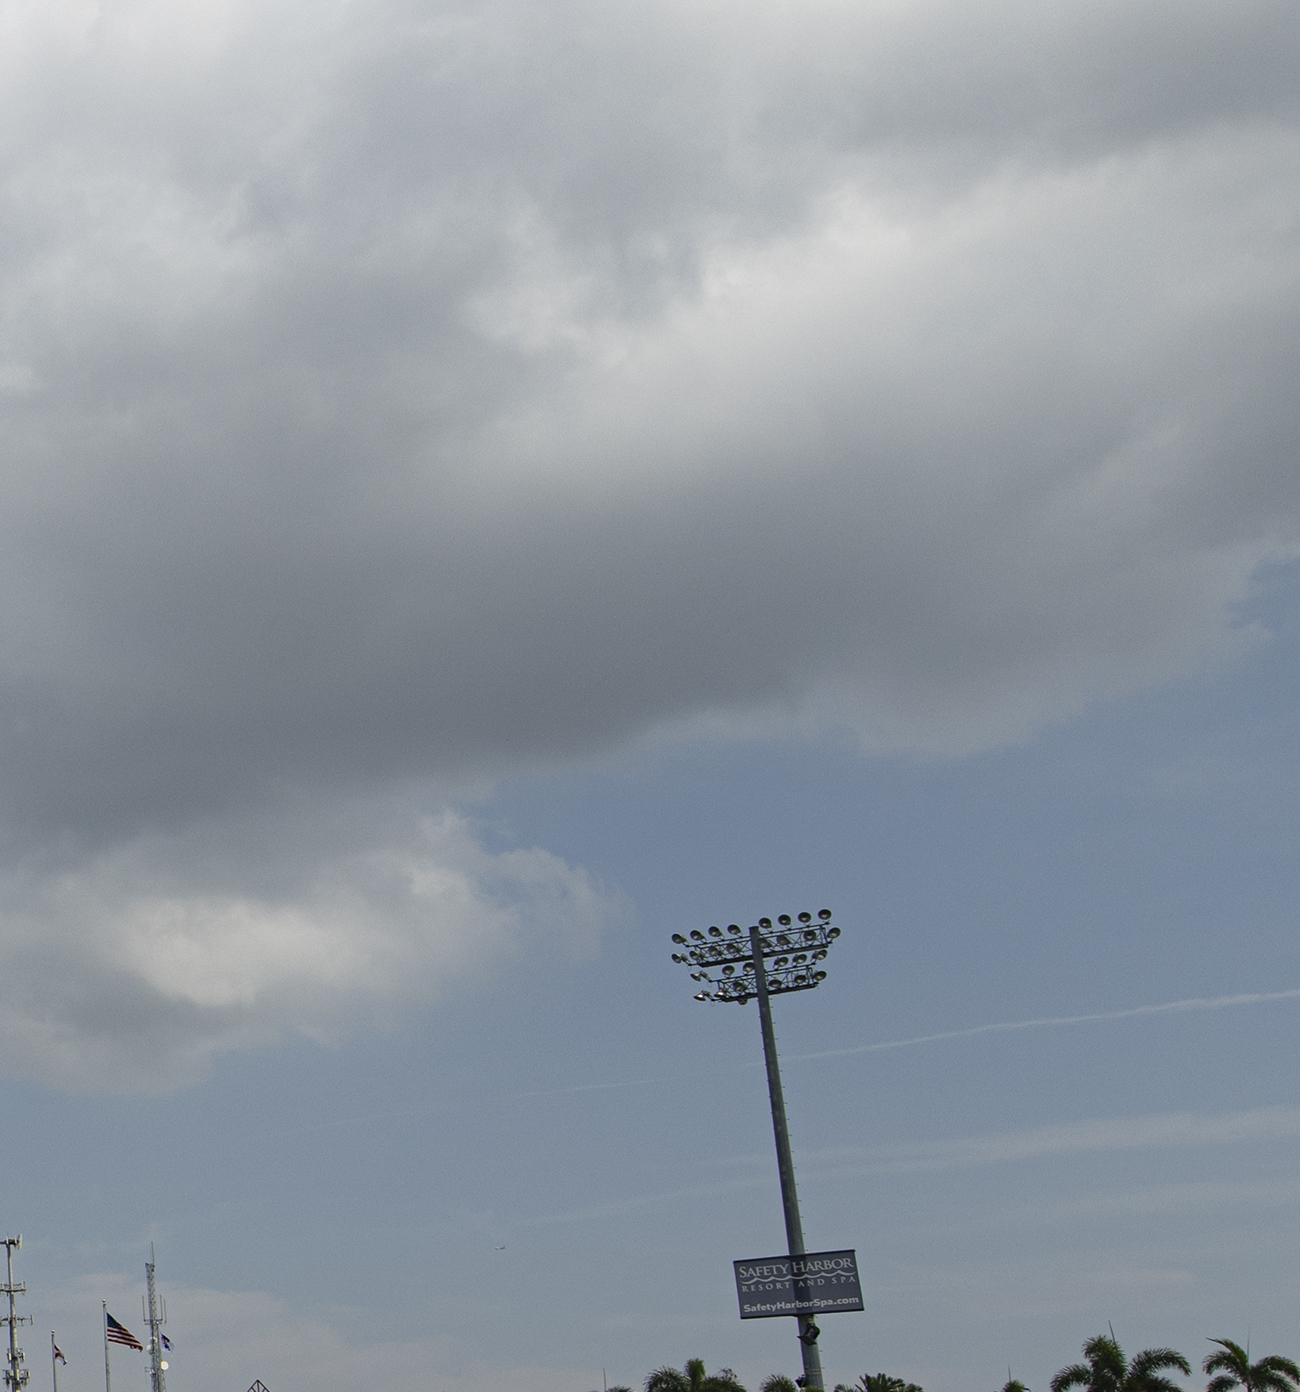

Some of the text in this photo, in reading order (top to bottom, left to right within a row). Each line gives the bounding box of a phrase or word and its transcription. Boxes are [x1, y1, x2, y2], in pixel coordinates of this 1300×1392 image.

[739, 1258, 854, 1278] SAFETY HARBOR
[742, 1276, 856, 1292] RESORT AND SPA
[743, 1297, 859, 1312] SafetyHarborSpa.com
